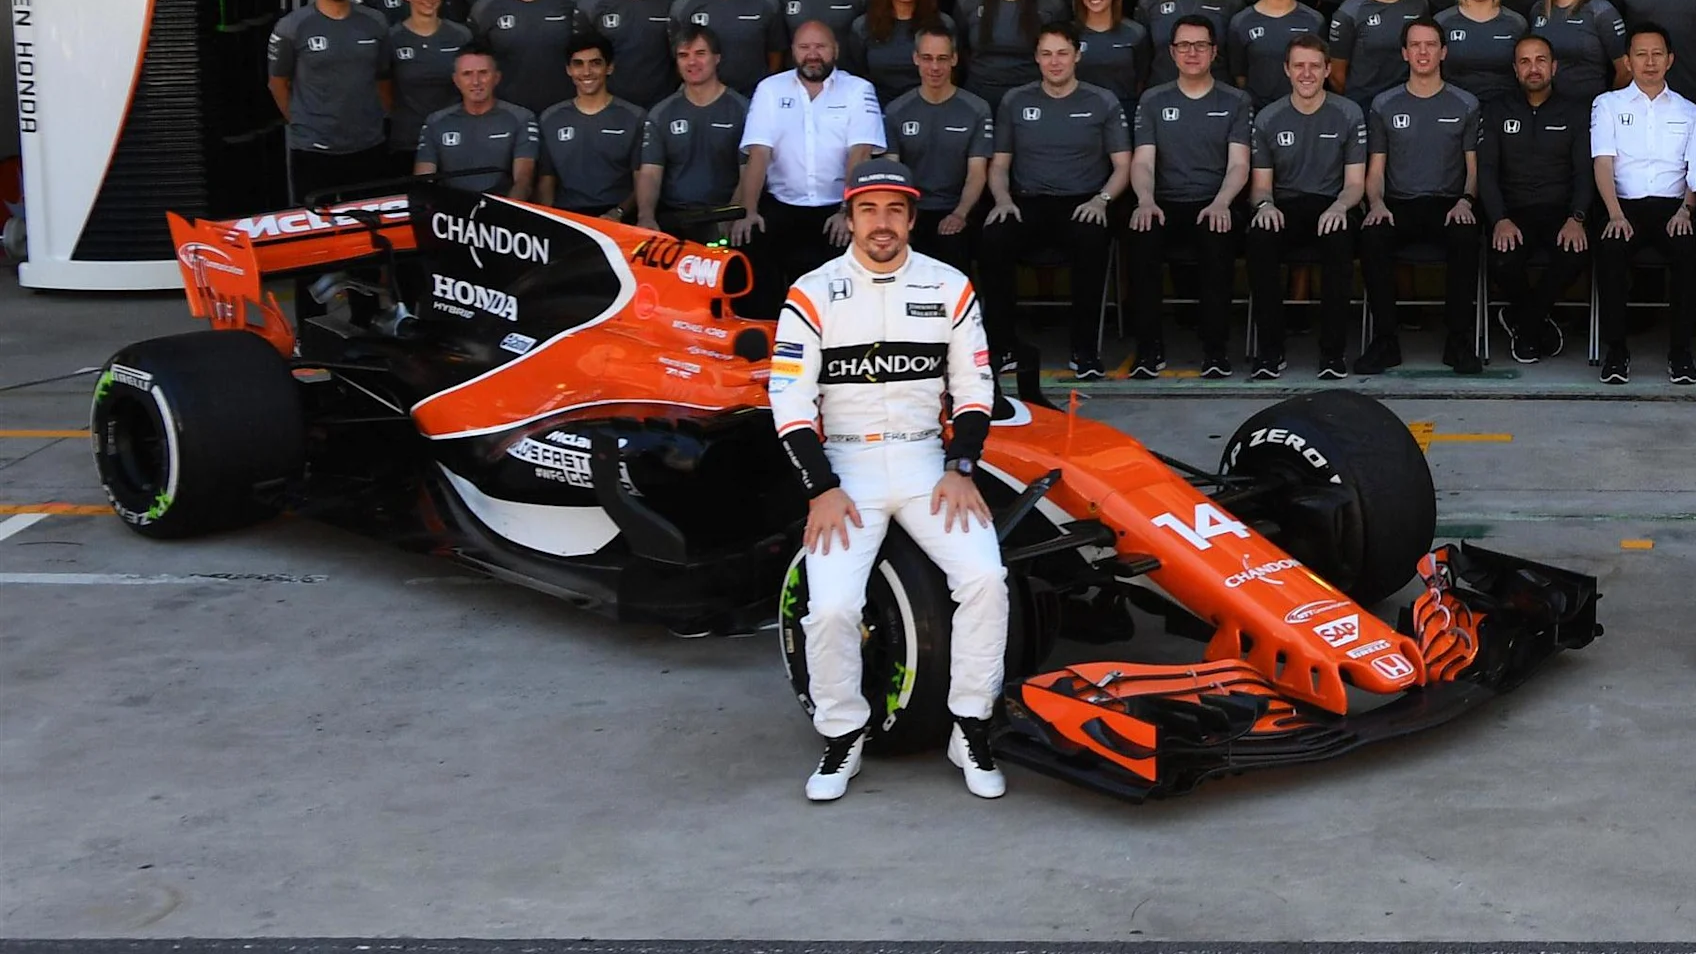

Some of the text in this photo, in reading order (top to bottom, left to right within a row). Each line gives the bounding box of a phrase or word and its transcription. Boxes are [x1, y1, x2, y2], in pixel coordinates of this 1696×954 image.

[16, 42, 38, 133] HONDA
[432, 211, 549, 265] CHANDON
[631, 235, 685, 271] ALO
[677, 255, 721, 288] CNN
[432, 273, 518, 321] HONDA
[828, 354, 942, 378] CHANDON
[1248, 428, 1328, 468] ZERO
[1151, 503, 1251, 551] 14
[1225, 558, 1302, 588] CHANDON
[1319, 621, 1356, 643] SAP
